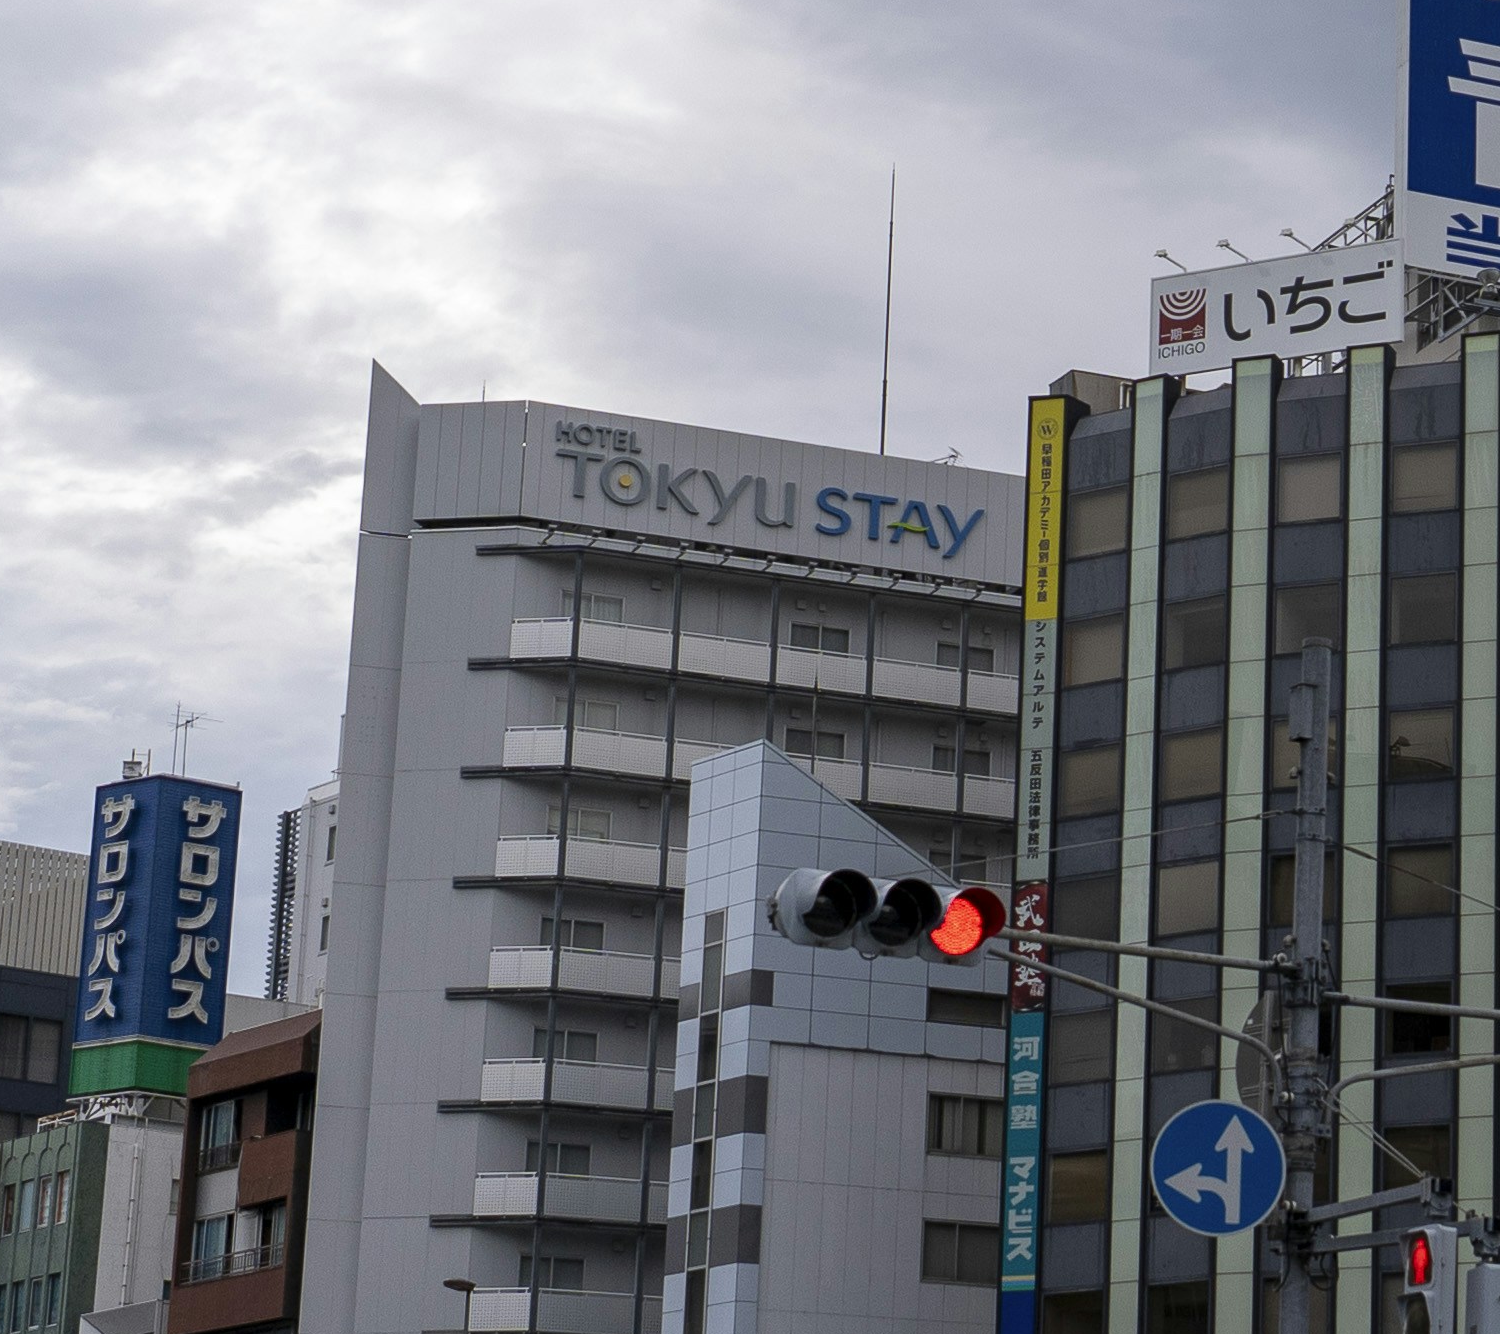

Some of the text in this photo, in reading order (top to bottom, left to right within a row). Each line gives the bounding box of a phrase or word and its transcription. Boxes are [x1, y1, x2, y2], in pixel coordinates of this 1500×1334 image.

[1158, 342, 1206, 359] ICHIGO
[1160, 324, 1205, 342] 一期一会
[1224, 259, 1393, 341] いちご
[556, 420, 642, 453] HOTEL
[556, 448, 985, 559] TOKYU STAY
[1032, 621, 1047, 729] システムアルテ
[1027, 750, 1042, 859] 五反田法律事務所
[85, 793, 136, 1022] サロンパス
[167, 795, 227, 1025] サロンパス
[1010, 1036, 1040, 1130] 河合塾
[1007, 1156, 1036, 1261] マナビス
